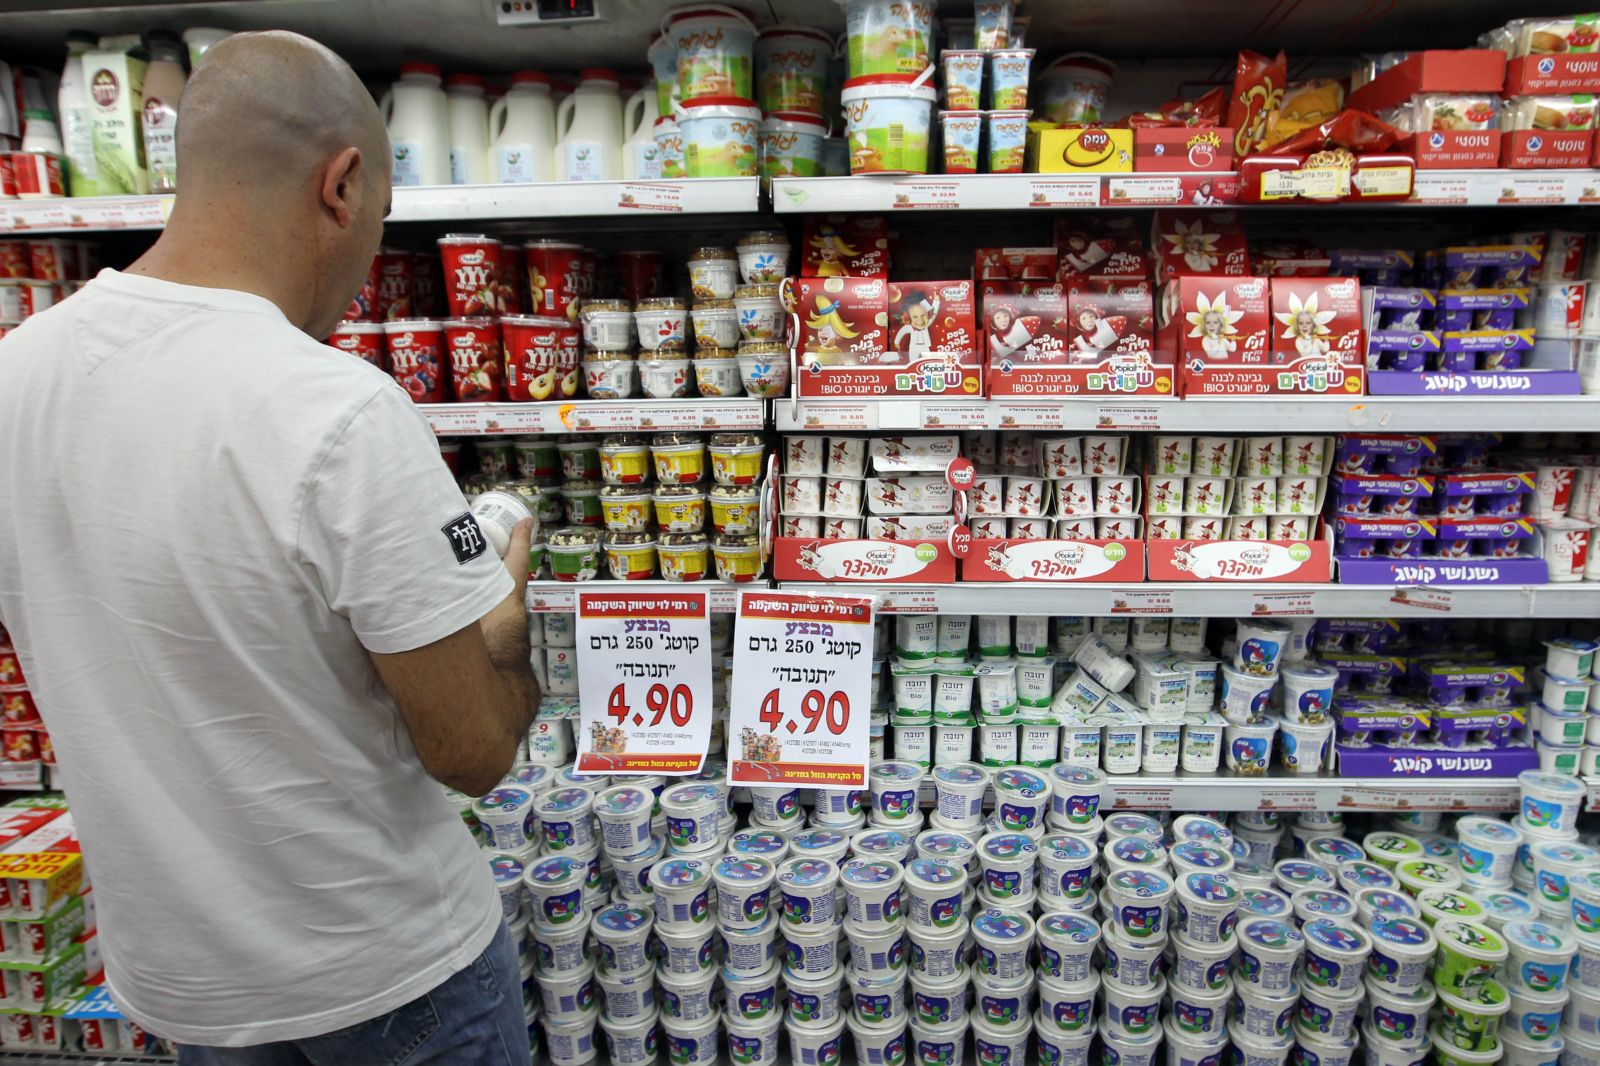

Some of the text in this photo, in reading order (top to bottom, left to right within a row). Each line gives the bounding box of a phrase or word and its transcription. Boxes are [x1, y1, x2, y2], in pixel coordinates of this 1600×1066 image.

[1083, 134, 1107, 145] עמק
[850, 339, 874, 353] בננה
[1041, 338, 1064, 351] תות
[1127, 338, 1150, 351] תות
[921, 362, 945, 374] Yoplait
[1113, 363, 1138, 373] Yoplait
[1304, 360, 1328, 370] Yoplait
[829, 372, 880, 384] גבינה לבנה
[1020, 371, 1071, 383] גבינה לבנה
[1211, 371, 1262, 383] גבינה לבנה
[1471, 375, 1531, 390] נשנושי
[845, 384, 872, 394] יוגורט
[873, 384, 888, 394] עם
[1036, 383, 1062, 393] יוגורט
[1065, 383, 1079, 393] עם
[1227, 383, 1253, 393] יוגורט
[1255, 384, 1270, 393] עם
[955, 533, 971, 543] מכיל
[957, 544, 968, 553] פרי
[842, 558, 889, 577] מוקצף
[1031, 558, 1077, 578] מוקצף
[1217, 558, 1264, 577] מוקצף
[1440, 566, 1500, 581] נשנושי
[586, 599, 688, 612] רמי לוי שיווק השקמה
[748, 600, 853, 615] רמי לוי שיווק השקמה
[624, 619, 671, 634] מבצע
[784, 621, 834, 637] מבצע
[589, 633, 700, 655] קוטג' 250 גרם
[748, 635, 862, 660] קוטג' 250 גרם
[557, 653, 566, 662] 9
[607, 682, 694, 728] 4.90
[759, 687, 851, 736] 4.90
[539, 723, 548, 733] 9
[626, 760, 650, 768] במדינה
[665, 760, 688, 769] הקניות
[688, 759, 698, 768] סל
[1436, 758, 1493, 771] נשנושי
[784, 770, 810, 779] במדינה
[826, 771, 851, 782] הקניות
[851, 771, 862, 780] סל
